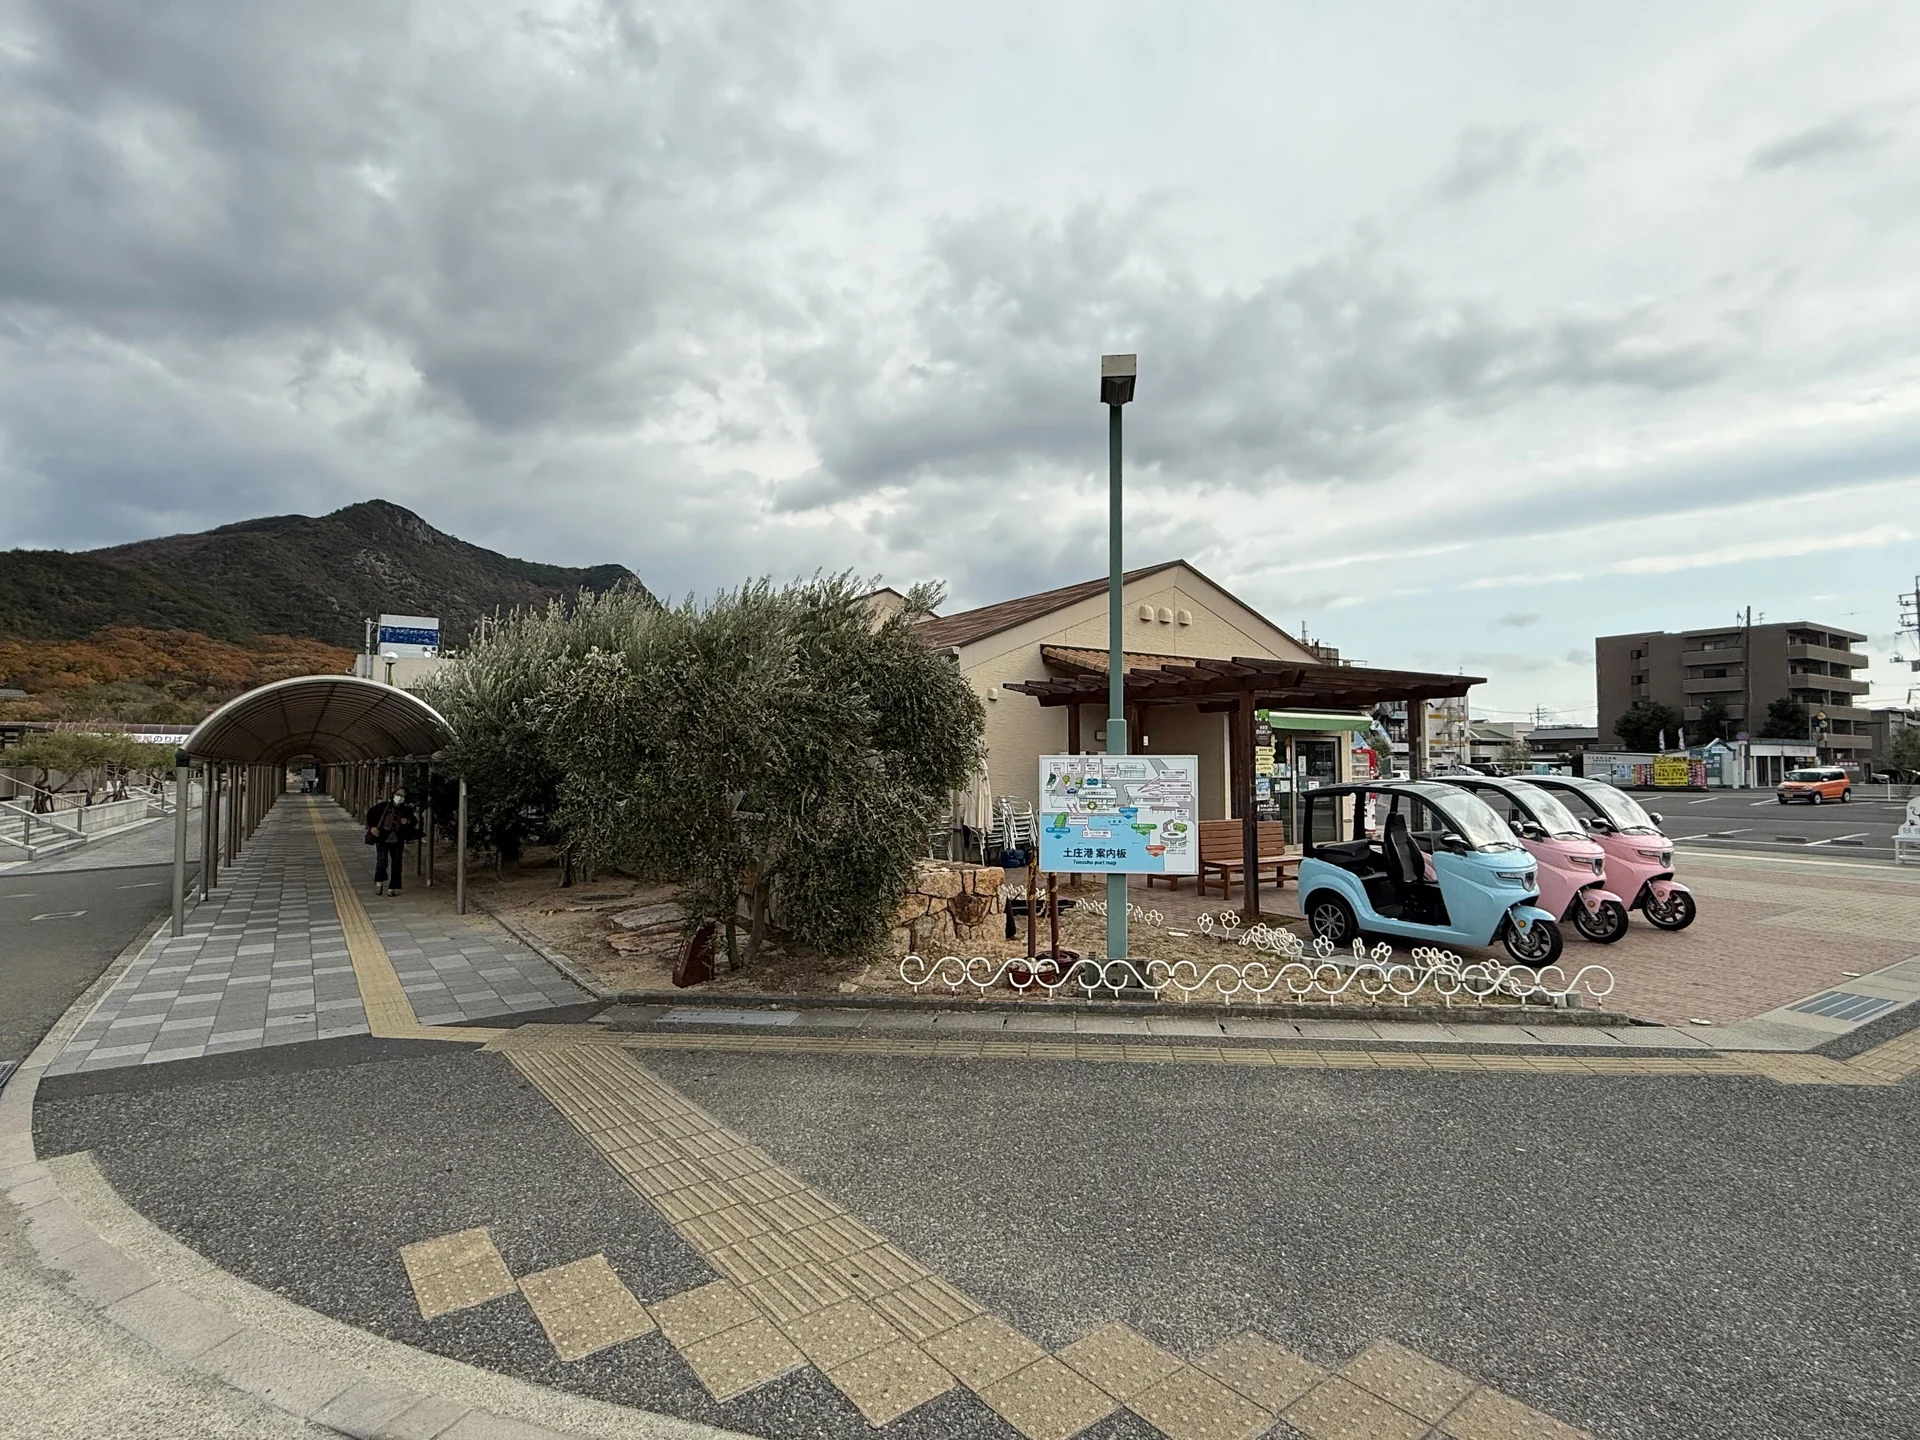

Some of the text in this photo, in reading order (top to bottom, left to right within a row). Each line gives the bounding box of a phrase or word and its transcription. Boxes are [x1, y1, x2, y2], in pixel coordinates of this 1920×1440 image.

[1063, 847, 1127, 859] 土庄港 案内板
